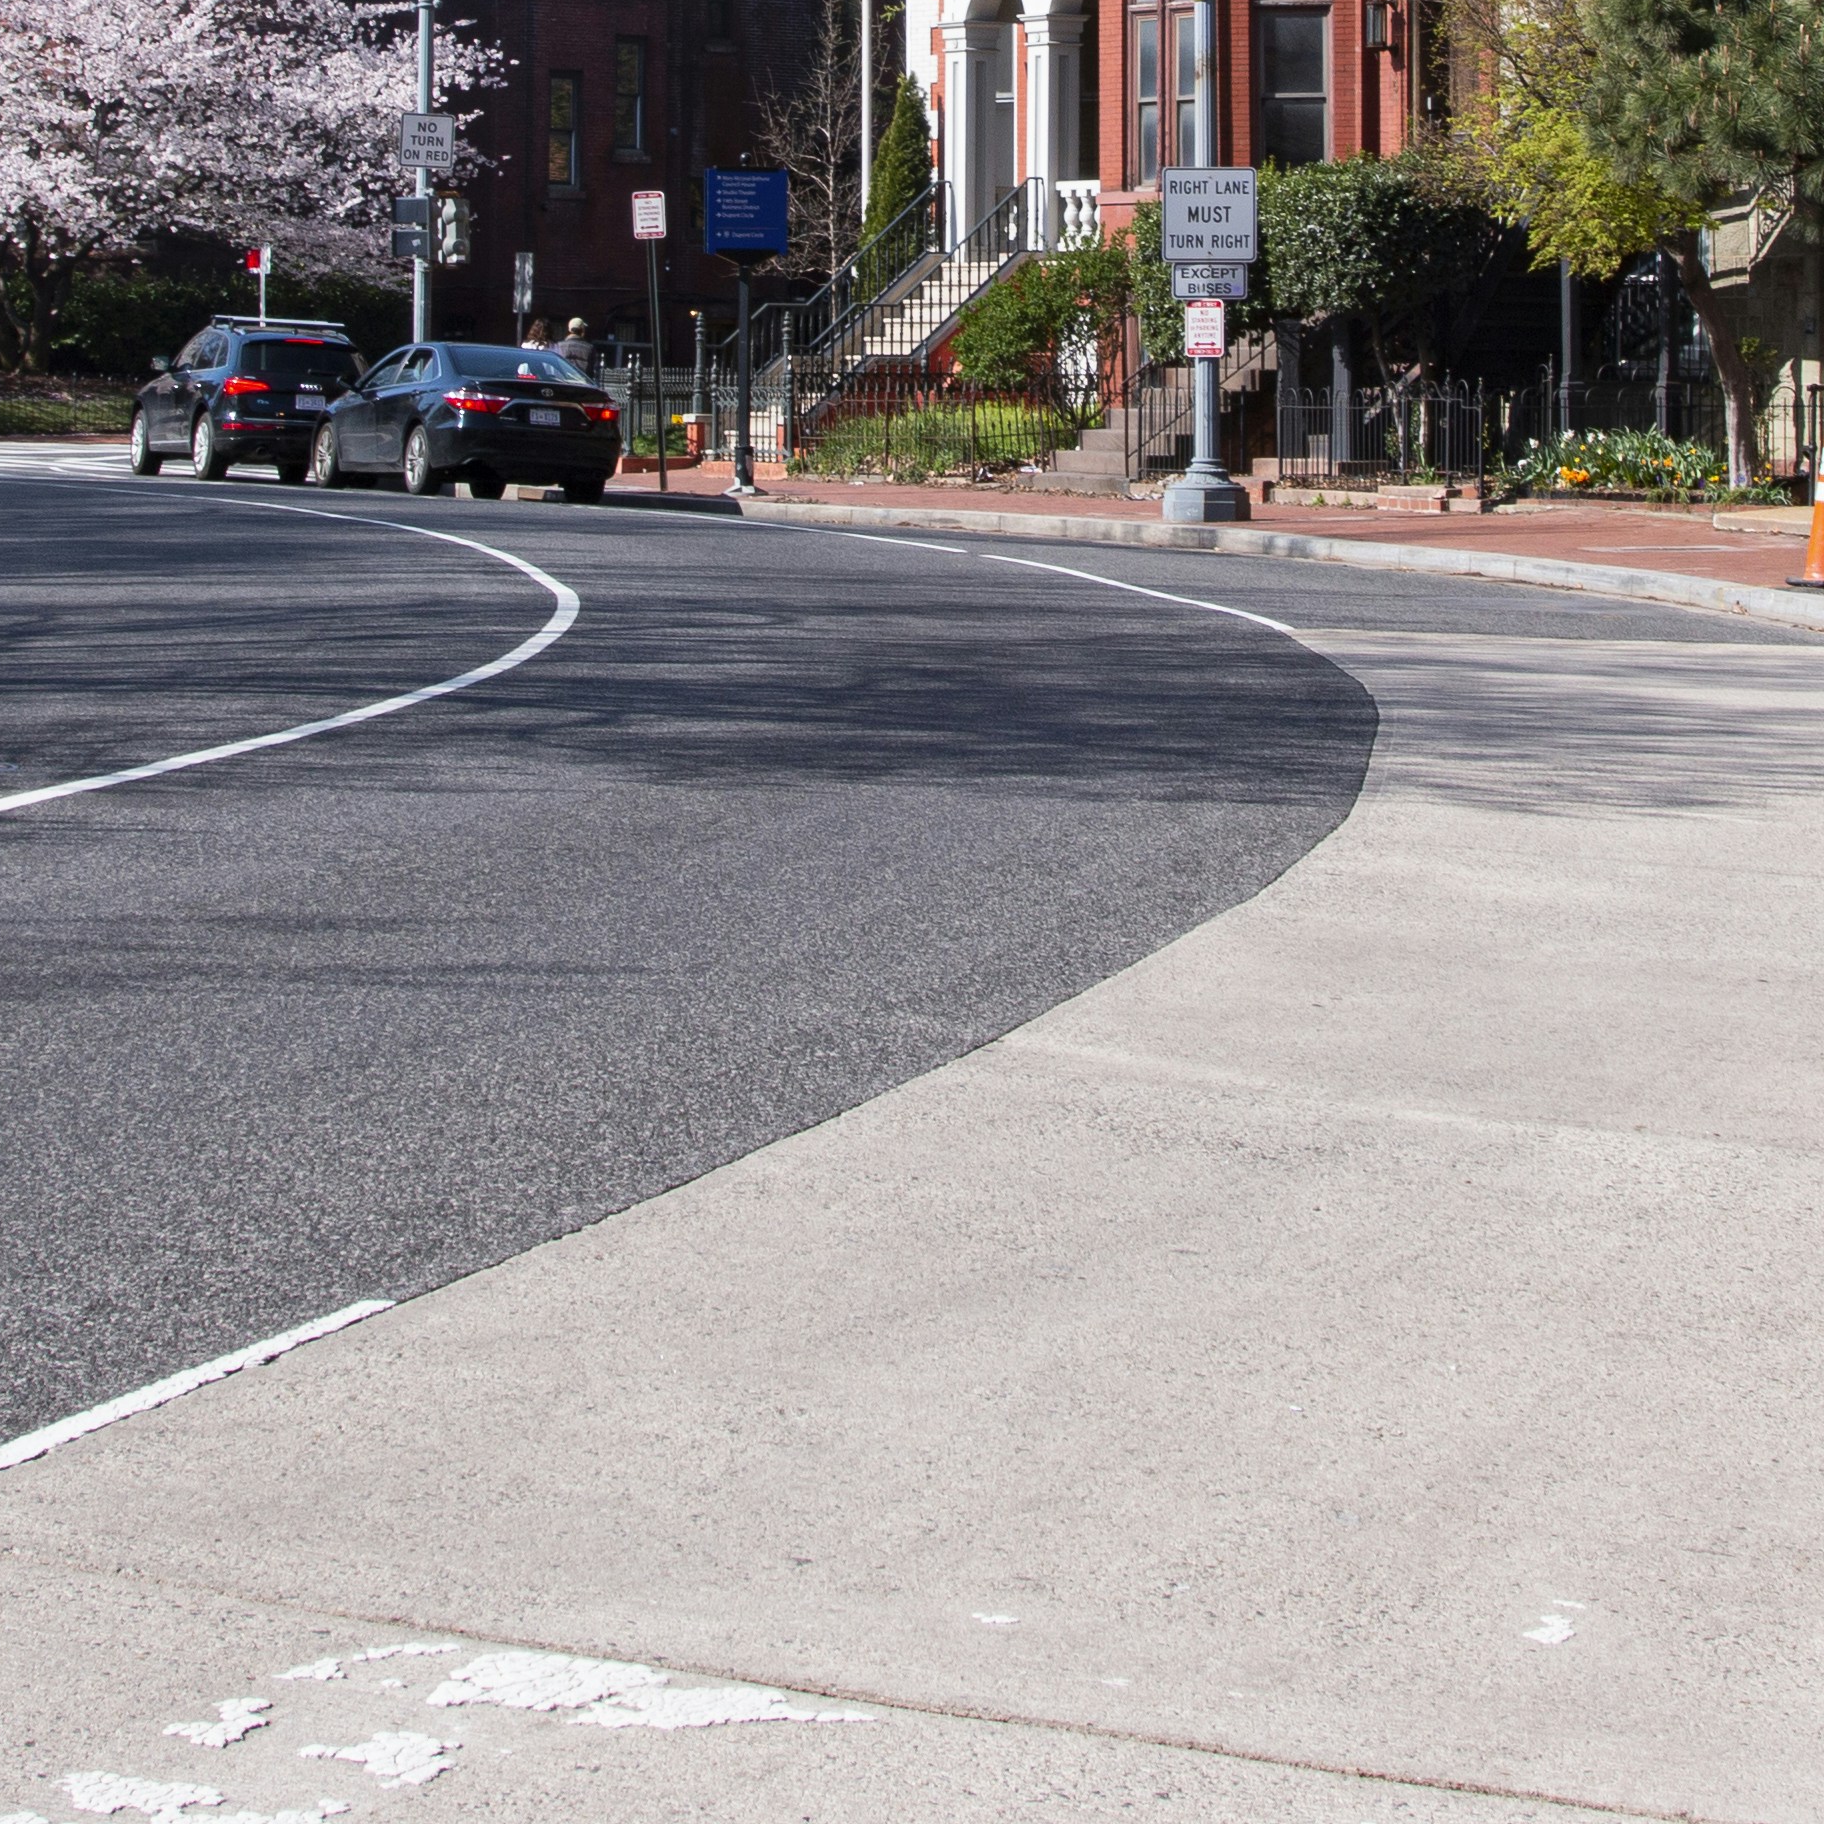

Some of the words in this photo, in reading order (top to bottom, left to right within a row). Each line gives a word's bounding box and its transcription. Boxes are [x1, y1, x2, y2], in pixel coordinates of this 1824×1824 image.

[418, 122, 437, 133] NO
[410, 135, 444, 146] TURN
[404, 149, 420, 160] ON
[426, 151, 449, 161] RED
[1170, 180, 1208, 194] RIGHT
[1216, 181, 1249, 194] LANE
[1188, 206, 1231, 223] MUST
[1169, 235, 1204, 248] TURN
[1212, 235, 1250, 248] RIGHT
[1181, 268, 1238, 279] EXCEPT
[1188, 283, 1232, 294] BUSES
